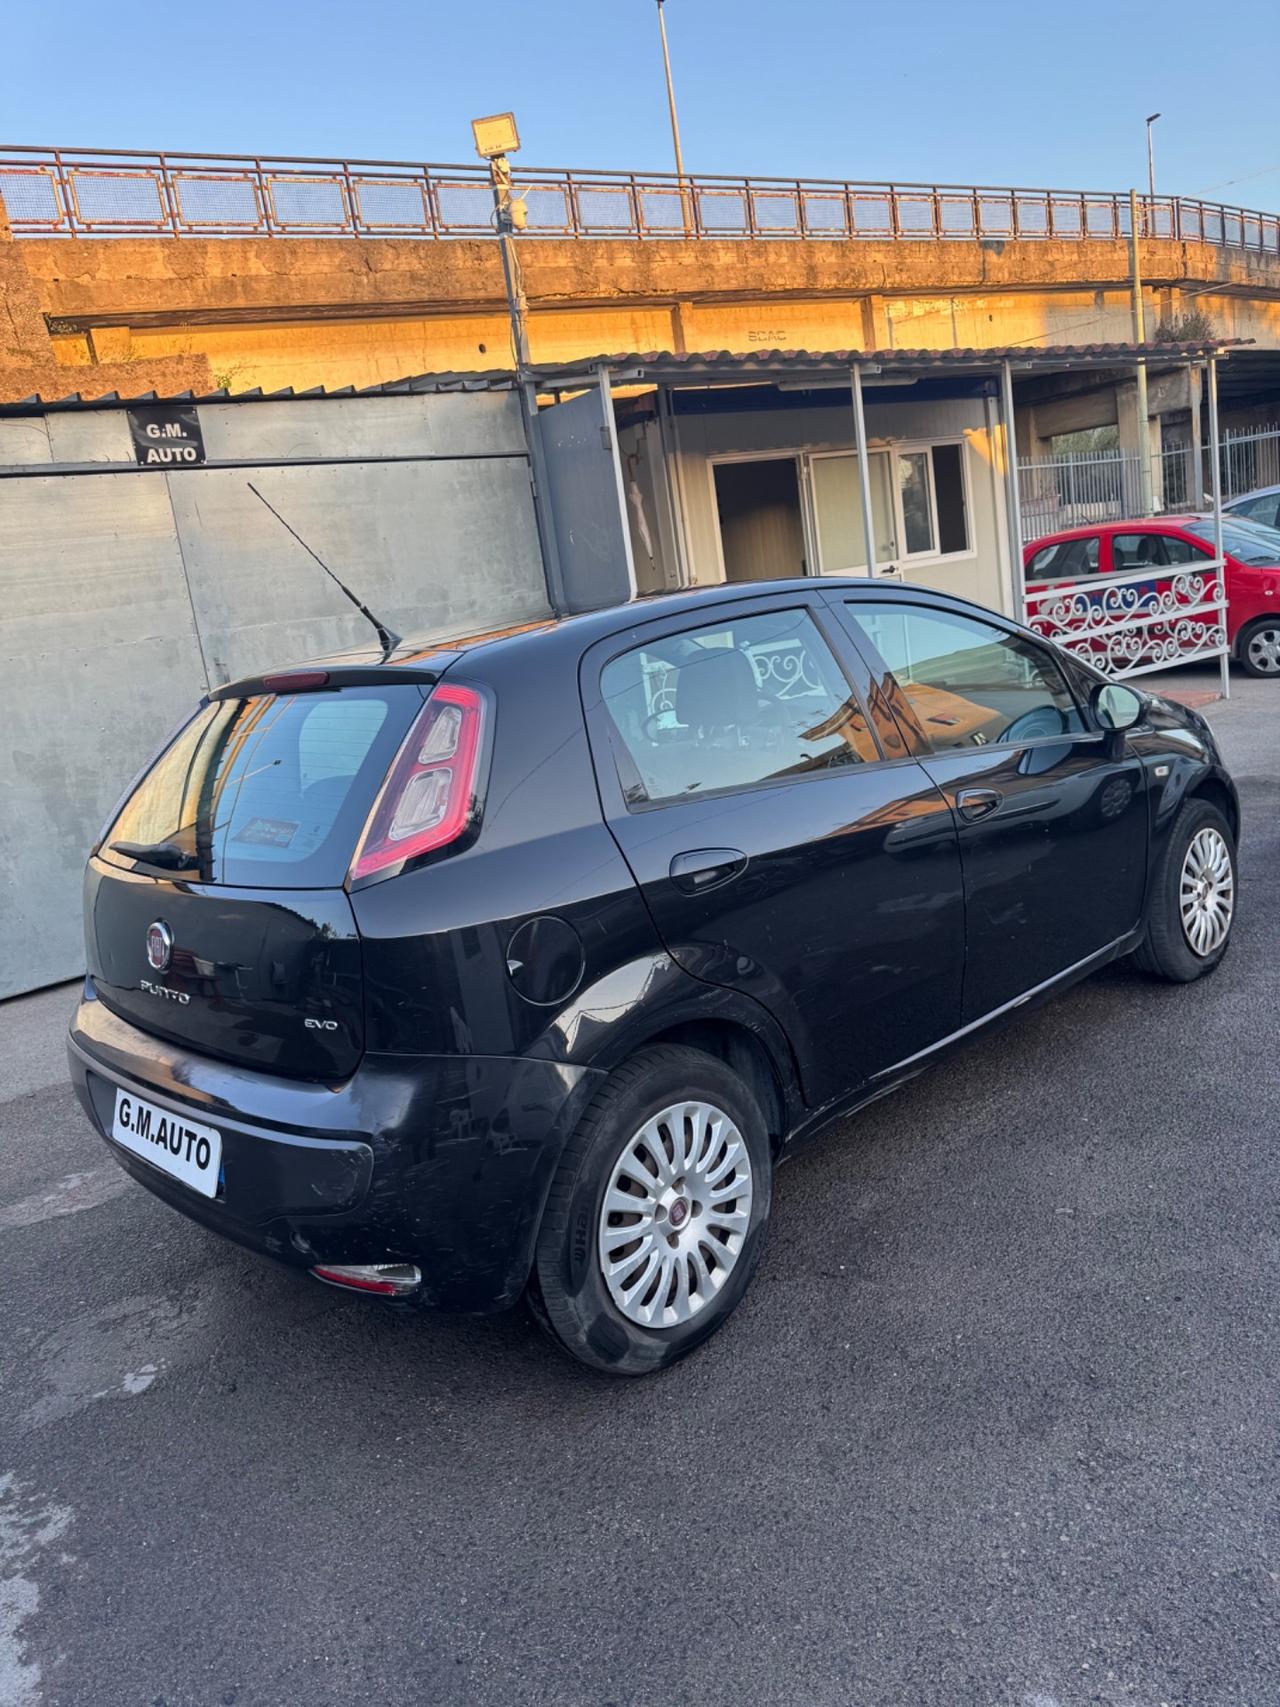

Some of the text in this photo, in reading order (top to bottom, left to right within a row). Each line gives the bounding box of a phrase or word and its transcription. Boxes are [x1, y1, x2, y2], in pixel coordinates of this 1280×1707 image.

[146, 423, 187, 438] G.M.
[147, 447, 197, 463] AUTO
[304, 1018, 338, 1030] EVO
[119, 1098, 211, 1171] G.M.AUTO
